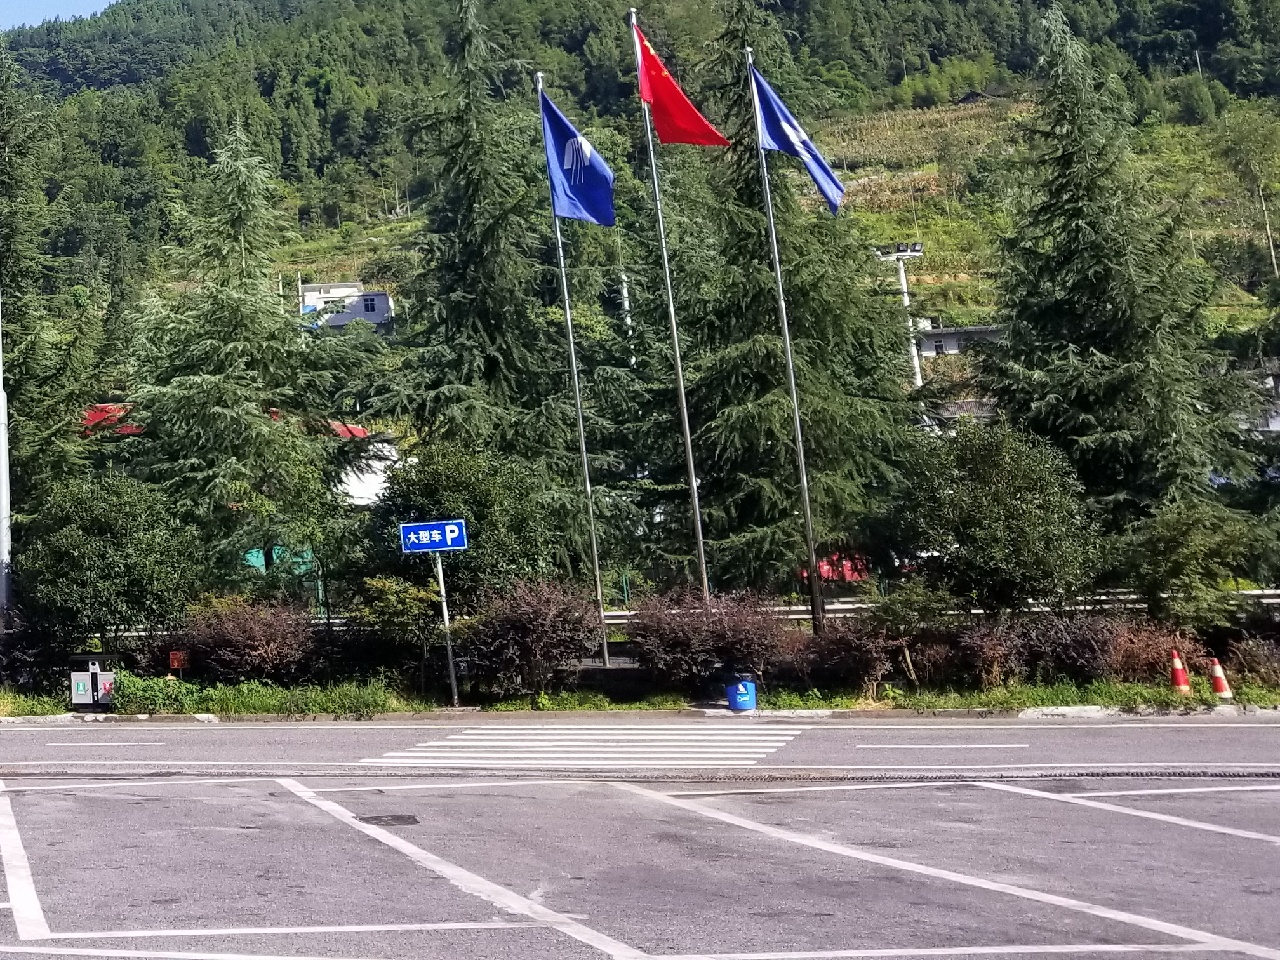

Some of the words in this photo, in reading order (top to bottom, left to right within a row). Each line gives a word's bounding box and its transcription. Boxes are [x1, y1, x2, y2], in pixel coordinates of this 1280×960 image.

[407, 529, 443, 545] 大型车
[444, 524, 459, 545] P
